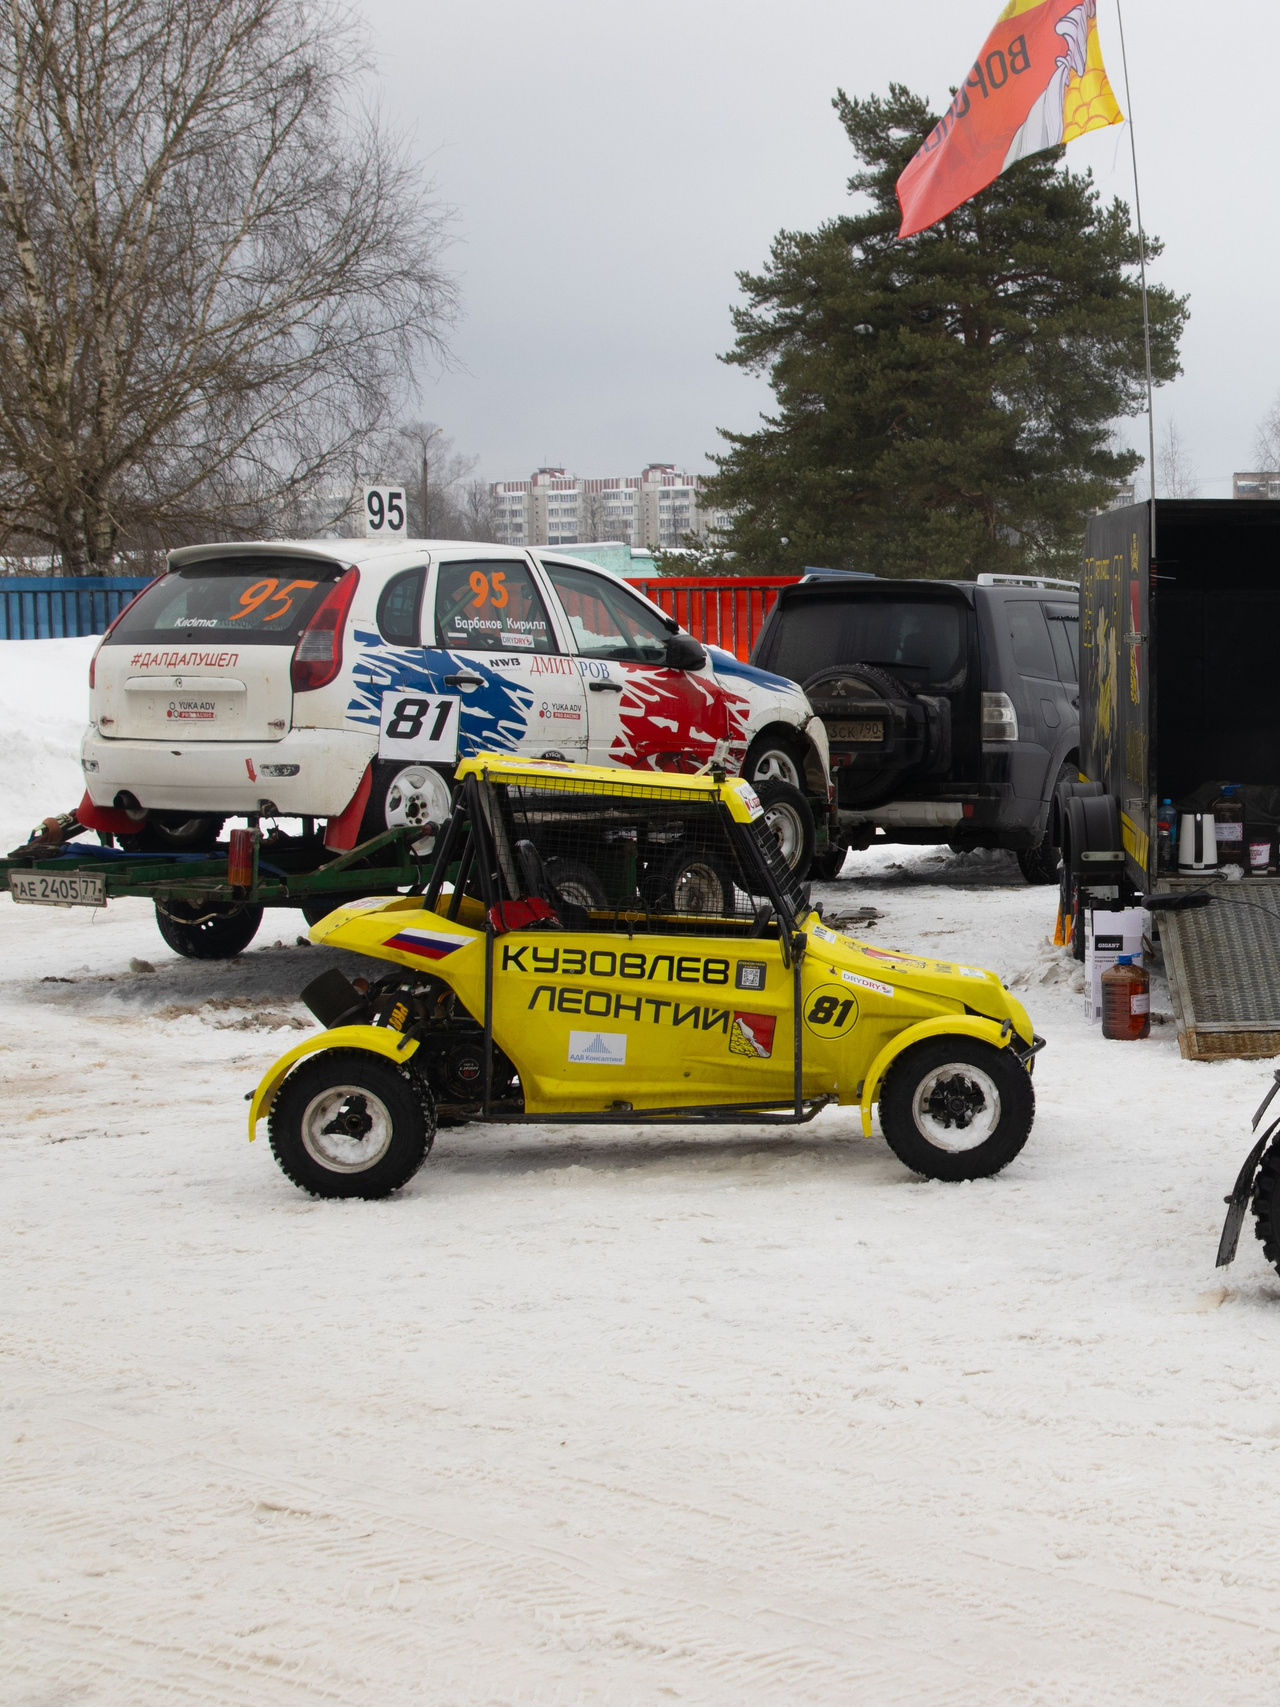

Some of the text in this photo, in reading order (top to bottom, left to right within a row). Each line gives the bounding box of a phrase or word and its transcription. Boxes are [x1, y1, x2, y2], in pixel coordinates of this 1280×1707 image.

[367, 490, 404, 531] 95
[229, 578, 319, 622] 95
[469, 570, 508, 609] 95
[454, 616, 546, 633] Барбаков Кирилл
[178, 701, 215, 710] YUKA ADV
[385, 697, 454, 741] 81
[551, 702, 582, 712] YUKA ADV
[858, 722, 878, 735] 790
[40, 878, 79, 900] 2405
[82, 880, 97, 895] 77
[501, 944, 730, 985] КУЗОВЛЕВ
[843, 972, 881, 991] DRYDRY
[528, 985, 730, 1034] ЛЕОНТИЙ
[807, 995, 855, 1028] 81
[585, 1055, 624, 1063] Консалтинг
